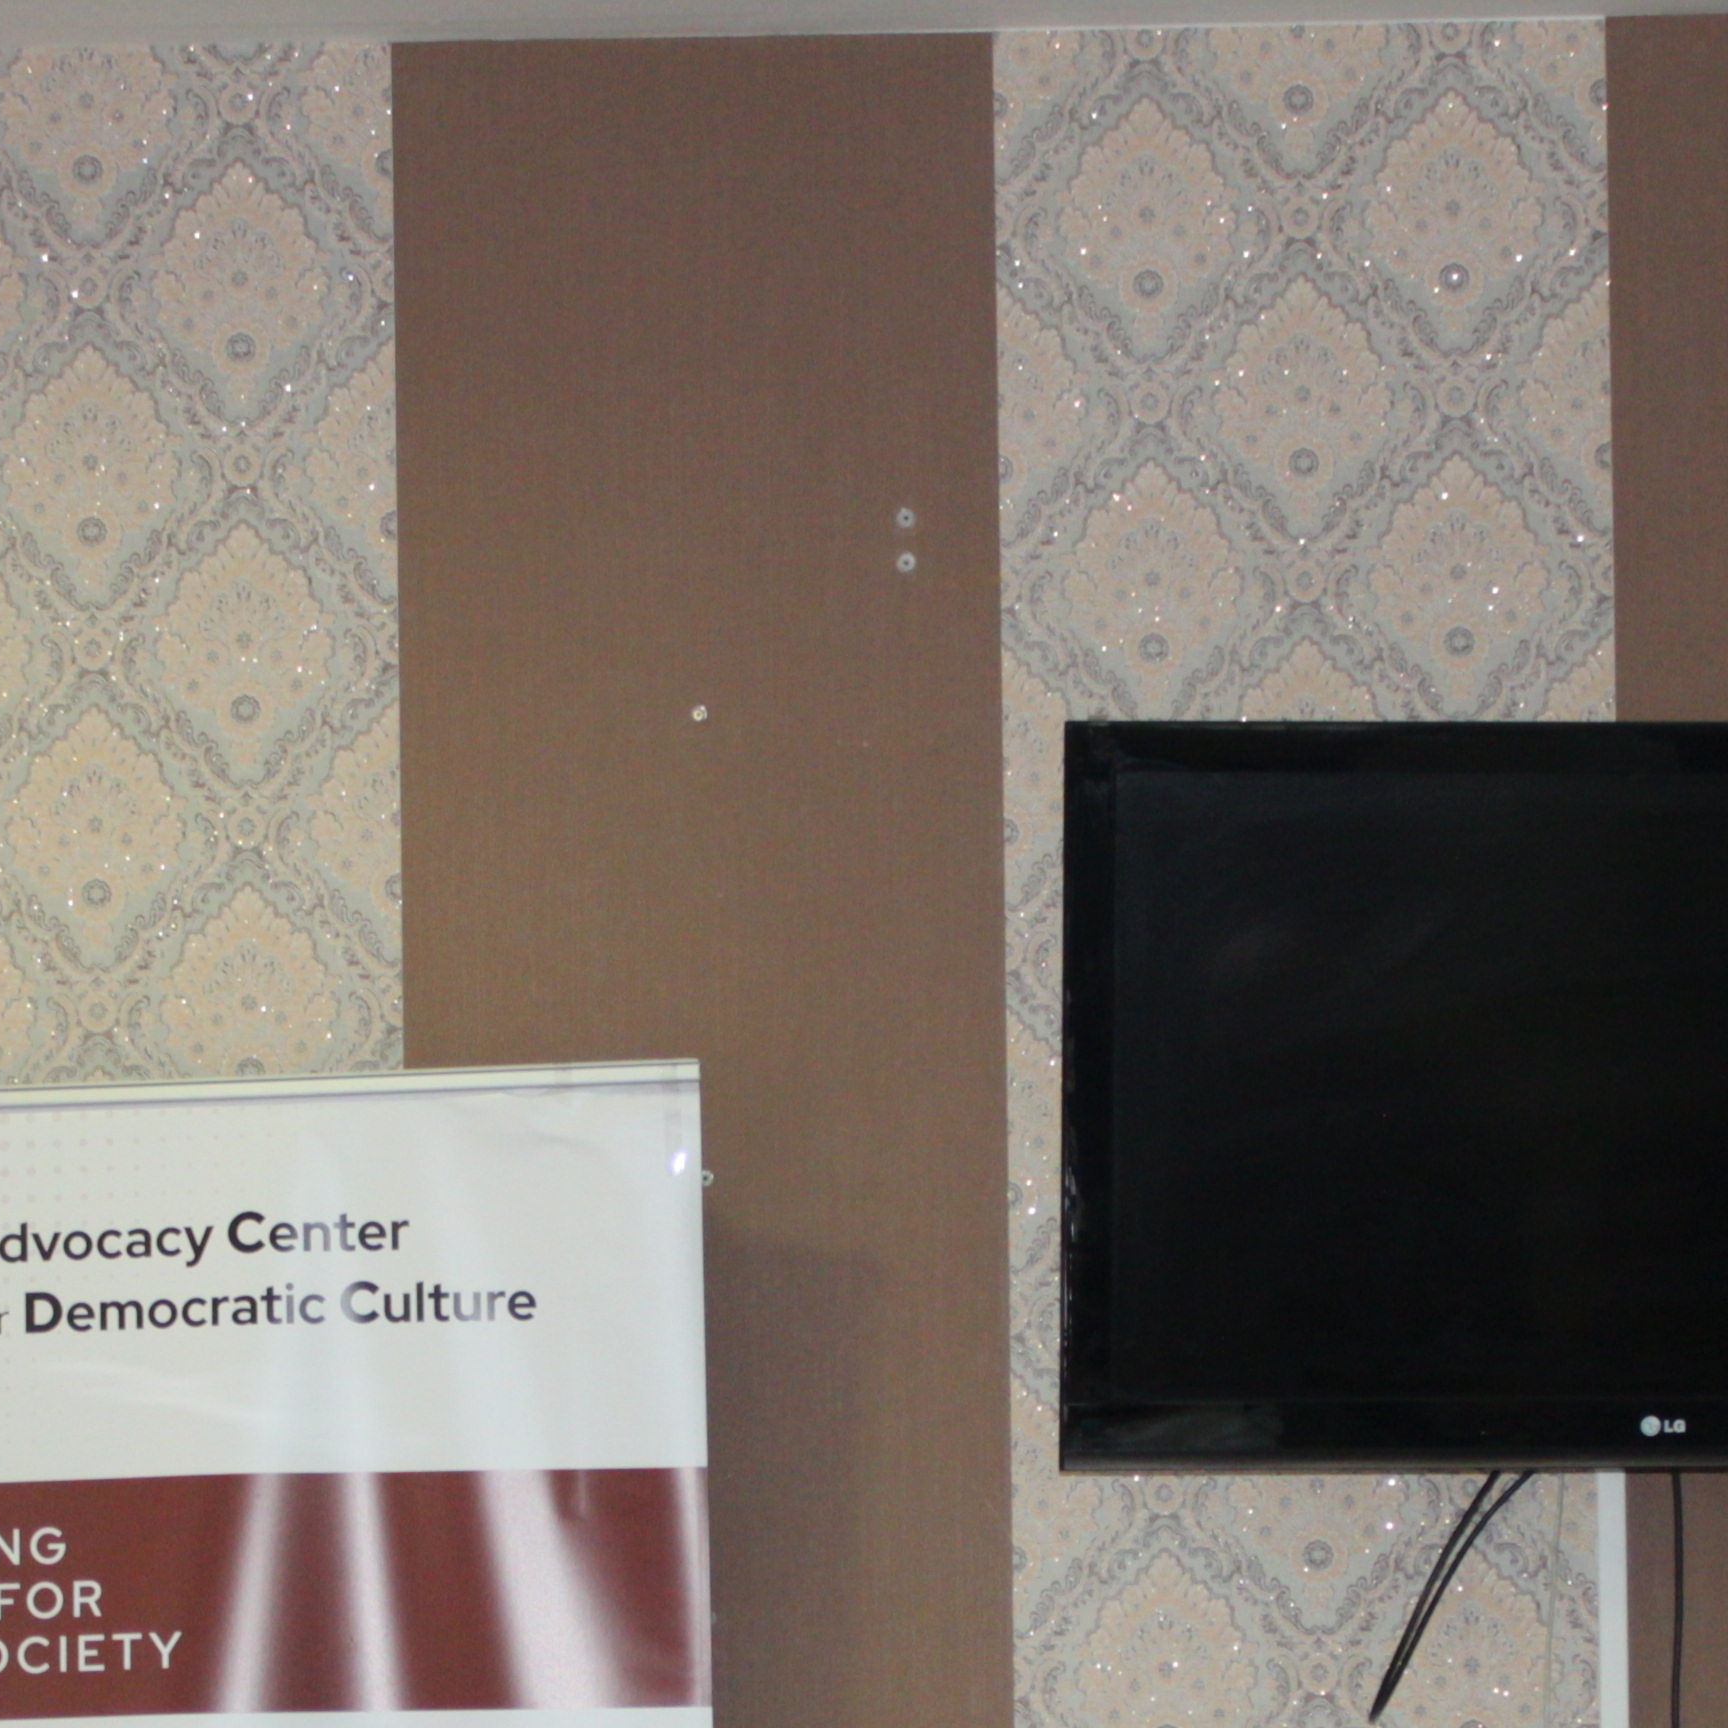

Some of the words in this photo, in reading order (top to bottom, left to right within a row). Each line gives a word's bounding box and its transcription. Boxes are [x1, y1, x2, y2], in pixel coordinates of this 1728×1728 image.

[227, 1210, 409, 1253] Center
[25, 1283, 326, 1334] Democratic
[341, 1281, 536, 1324] Culture
[1664, 1419, 1686, 1433] LG
